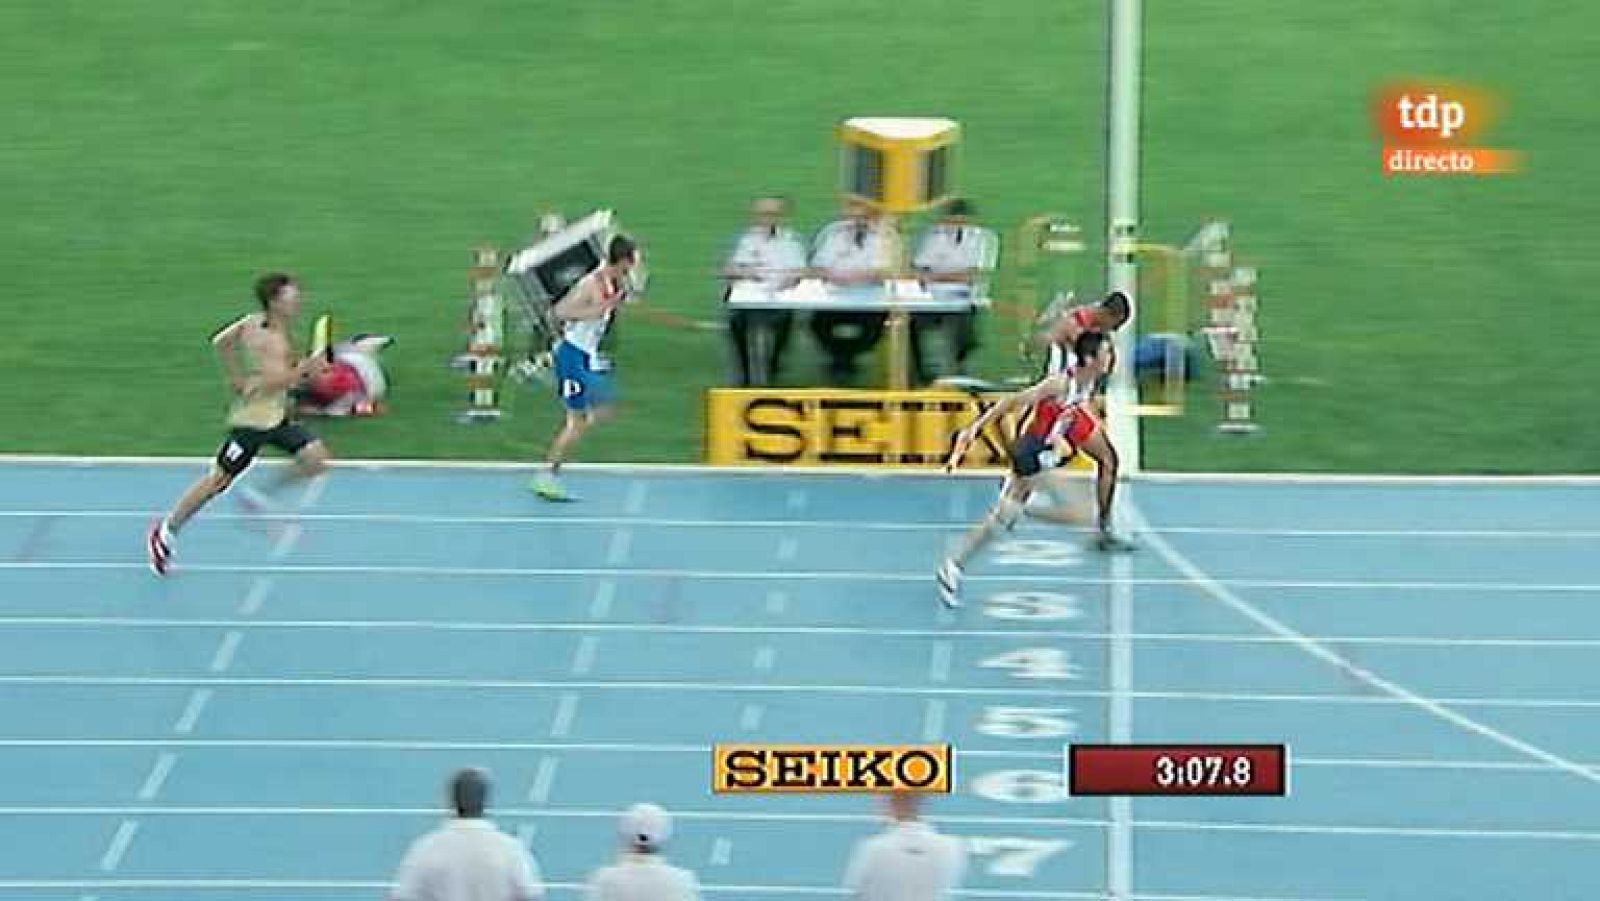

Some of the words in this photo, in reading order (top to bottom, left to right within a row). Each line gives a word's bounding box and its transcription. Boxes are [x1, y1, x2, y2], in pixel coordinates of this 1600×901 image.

[983, 592, 1082, 620] 3
[977, 649, 1082, 679] 4
[971, 706, 1082, 738] 5
[970, 770, 1066, 803] 6
[962, 836, 1077, 876] 7
